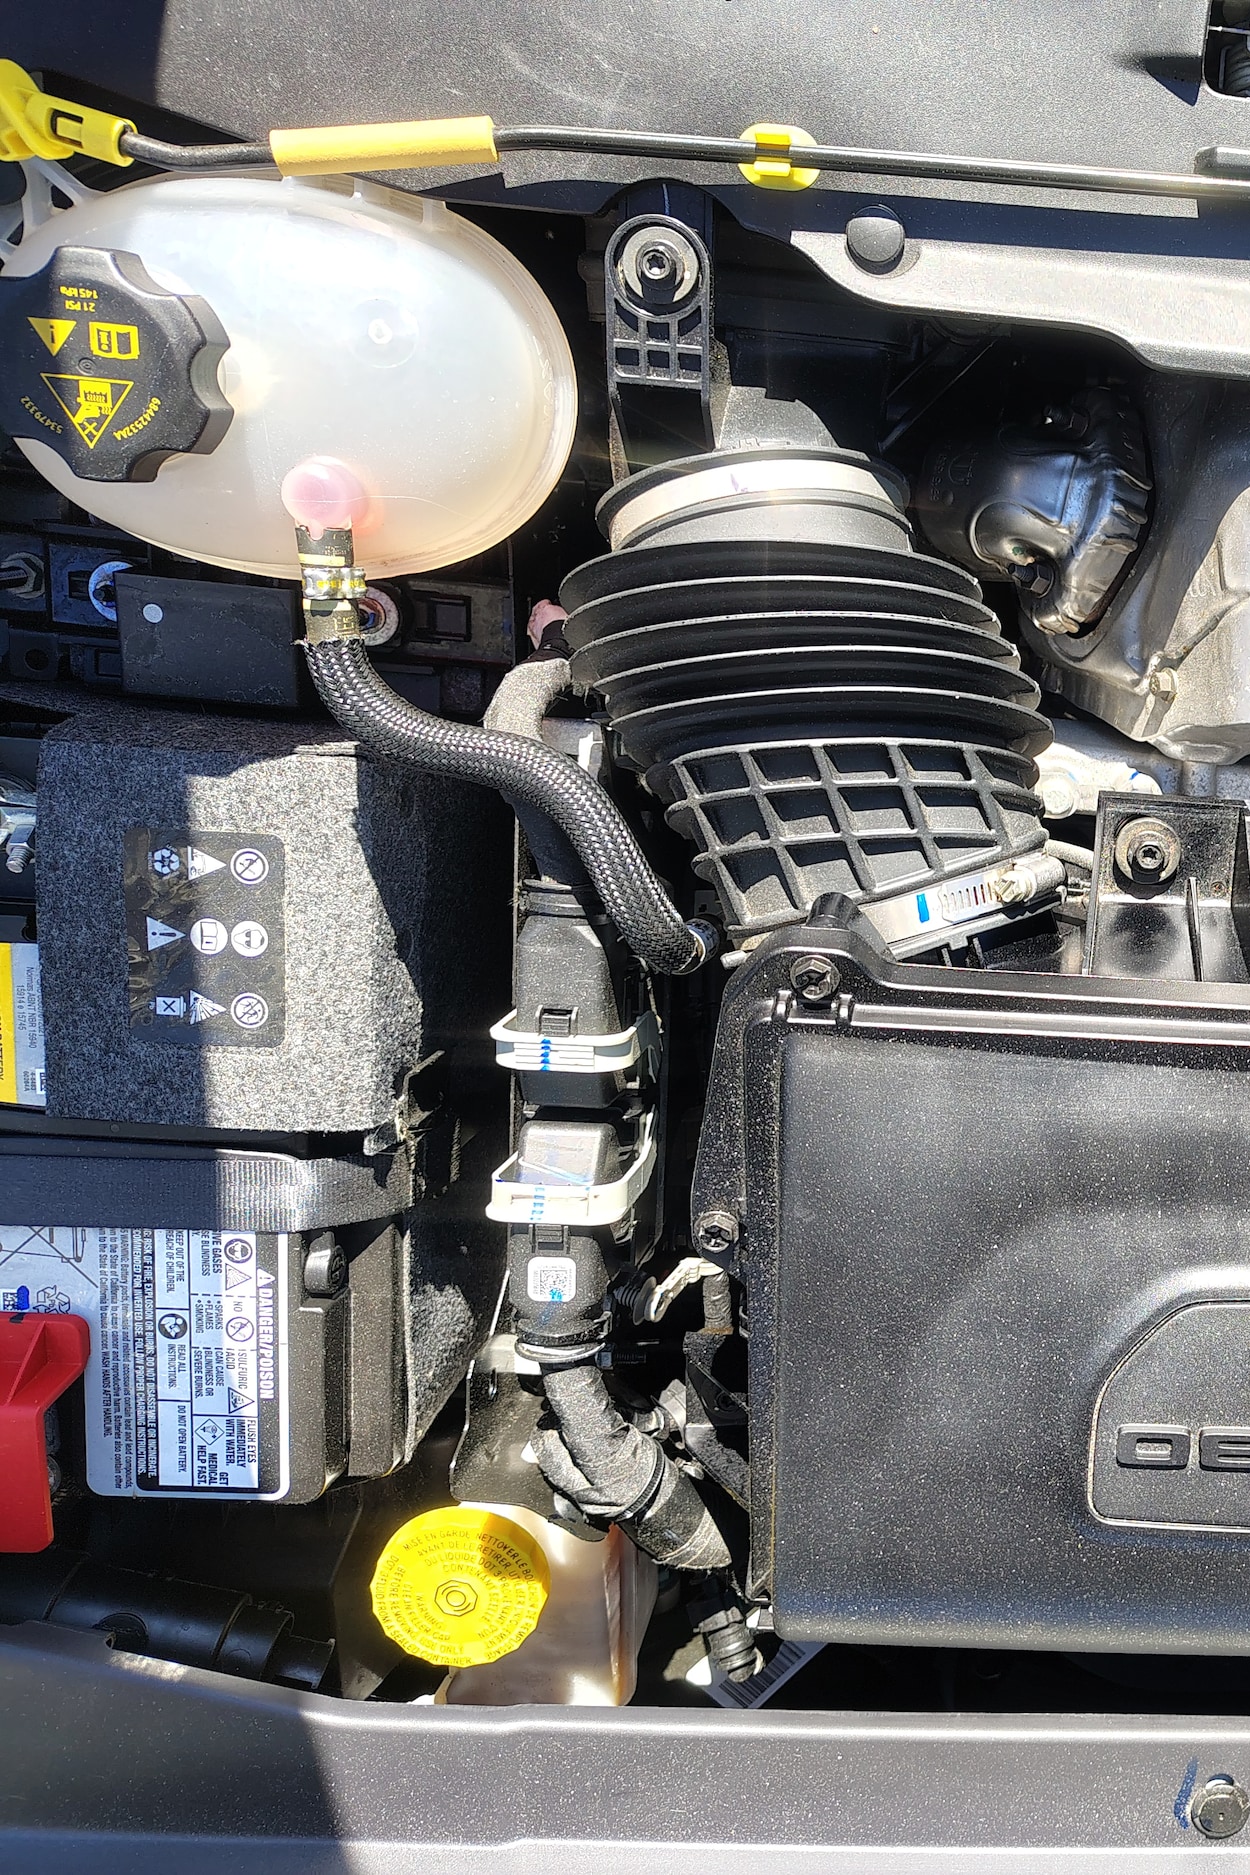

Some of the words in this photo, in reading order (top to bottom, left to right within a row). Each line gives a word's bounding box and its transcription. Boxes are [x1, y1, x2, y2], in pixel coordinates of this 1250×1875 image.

[60, 286, 79, 298] kPa
[80, 288, 98, 299] 145
[65, 300, 81, 311] PSI
[84, 301, 96, 312] 21
[26, 967, 35, 991] Normas
[27, 993, 36, 1011] ABNT
[28, 1013, 38, 1028] NBR
[143, 1238, 152, 1254] RISK
[166, 1230, 174, 1250] REACH
[175, 1230, 184, 1246] KEEP
[100, 1244, 108, 1253] the
[110, 1244, 118, 1253] the
[121, 1234, 129, 1262] WARNING:
[132, 1229, 142, 1273] COMMENDED
[166, 1252, 174, 1260] OF
[176, 1247, 184, 1259] OUT
[100, 1254, 108, 1269] State
[110, 1254, 119, 1269] State
[144, 1255, 152, 1264] OF
[176, 1261, 184, 1269] OF
[201, 1240, 210, 1276] BLINDNESS
[212, 1248, 222, 1273] GASES
[119, 1264, 130, 1283] Battery
[134, 1275, 142, 1287] FOR
[166, 1262, 175, 1293] CHILDREN.
[176, 1270, 184, 1282] THE
[100, 1278, 109, 1304] California
[110, 1278, 119, 1304] California
[119, 1285, 129, 1302] posts,
[134, 1289, 143, 1320] INVERTED
[144, 1283, 154, 1320] EXPLOSION
[233, 1301, 243, 1312] NO
[134, 1322, 143, 1336] USE.
[145, 1322, 154, 1330] OR
[122, 1331, 131, 1341] and
[259, 1289, 274, 1398] DANGER/POISON
[102, 1352, 110, 1367] WASH
[112, 1351, 120, 1361] and
[122, 1343, 132, 1362] related
[135, 1338, 144, 1365] FOLLOW
[178, 1344, 186, 1361] READ
[215, 1351, 223, 1365] CAN
[146, 1356, 154, 1367] DO
[168, 1344, 176, 1389] INSTRUCTIONS.
[178, 1362, 186, 1373] ALL
[194, 1350, 203, 1373] SEVERE
[204, 1351, 213, 1386] BLINDNESS
[226, 1352, 235, 1370] ACID
[102, 1369, 111, 1388] HANDS
[111, 1363, 121, 1396] reproductive
[123, 1363, 132, 1395] accessories
[135, 1366, 145, 1391] PROPER
[146, 1368, 155, 1381] NOT
[215, 1368, 224, 1387] CAUSE
[238, 1353, 247, 1389] SULFURIC
[194, 1376, 203, 1399] BURNS.
[205, 1388, 213, 1396] OR
[103, 1390, 112, 1406] AFTER
[113, 1398, 121, 1413] harm.
[124, 1397, 132, 1417] contain
[146, 1382, 156, 1427] DISASSEMBLE
[136, 1392, 146, 1425] CHARGING
[178, 1405, 186, 1413] DO
[103, 1408, 112, 1438] HANDLING.
[114, 1415, 122, 1439] Batteries
[124, 1418, 133, 1430] lead
[178, 1415, 186, 1427] NOT
[226, 1419, 235, 1437] WITH
[125, 1432, 133, 1441] and
[147, 1428, 156, 1438] OR
[178, 1428, 186, 1444] OPEN
[247, 1420, 256, 1442] FLUSH
[114, 1440, 122, 1452] also
[125, 1443, 133, 1454] lead
[137, 1426, 146, 1475] INSTRUCTIONS.
[226, 1439, 235, 1466] WATER.
[236, 1419, 246, 1468] IMMEDIATELY
[147, 1439, 157, 1478] INCINERATE.
[178, 1446, 187, 1473] BATTERY.
[197, 1445, 206, 1464] HELP
[248, 1445, 256, 1463] EYES
[123, 1456, 133, 1489] compounds,
[198, 1466, 206, 1484] FAST.
[208, 1453, 218, 1485] MEDICAL
[115, 1475, 123, 1489] other
[219, 1472, 228, 1486] GET
[403, 1537, 423, 1551] MISE
[477, 1533, 519, 1560] NETTOYER
[479, 1557, 496, 1571] DOT
[391, 1630, 420, 1654] SEALED
